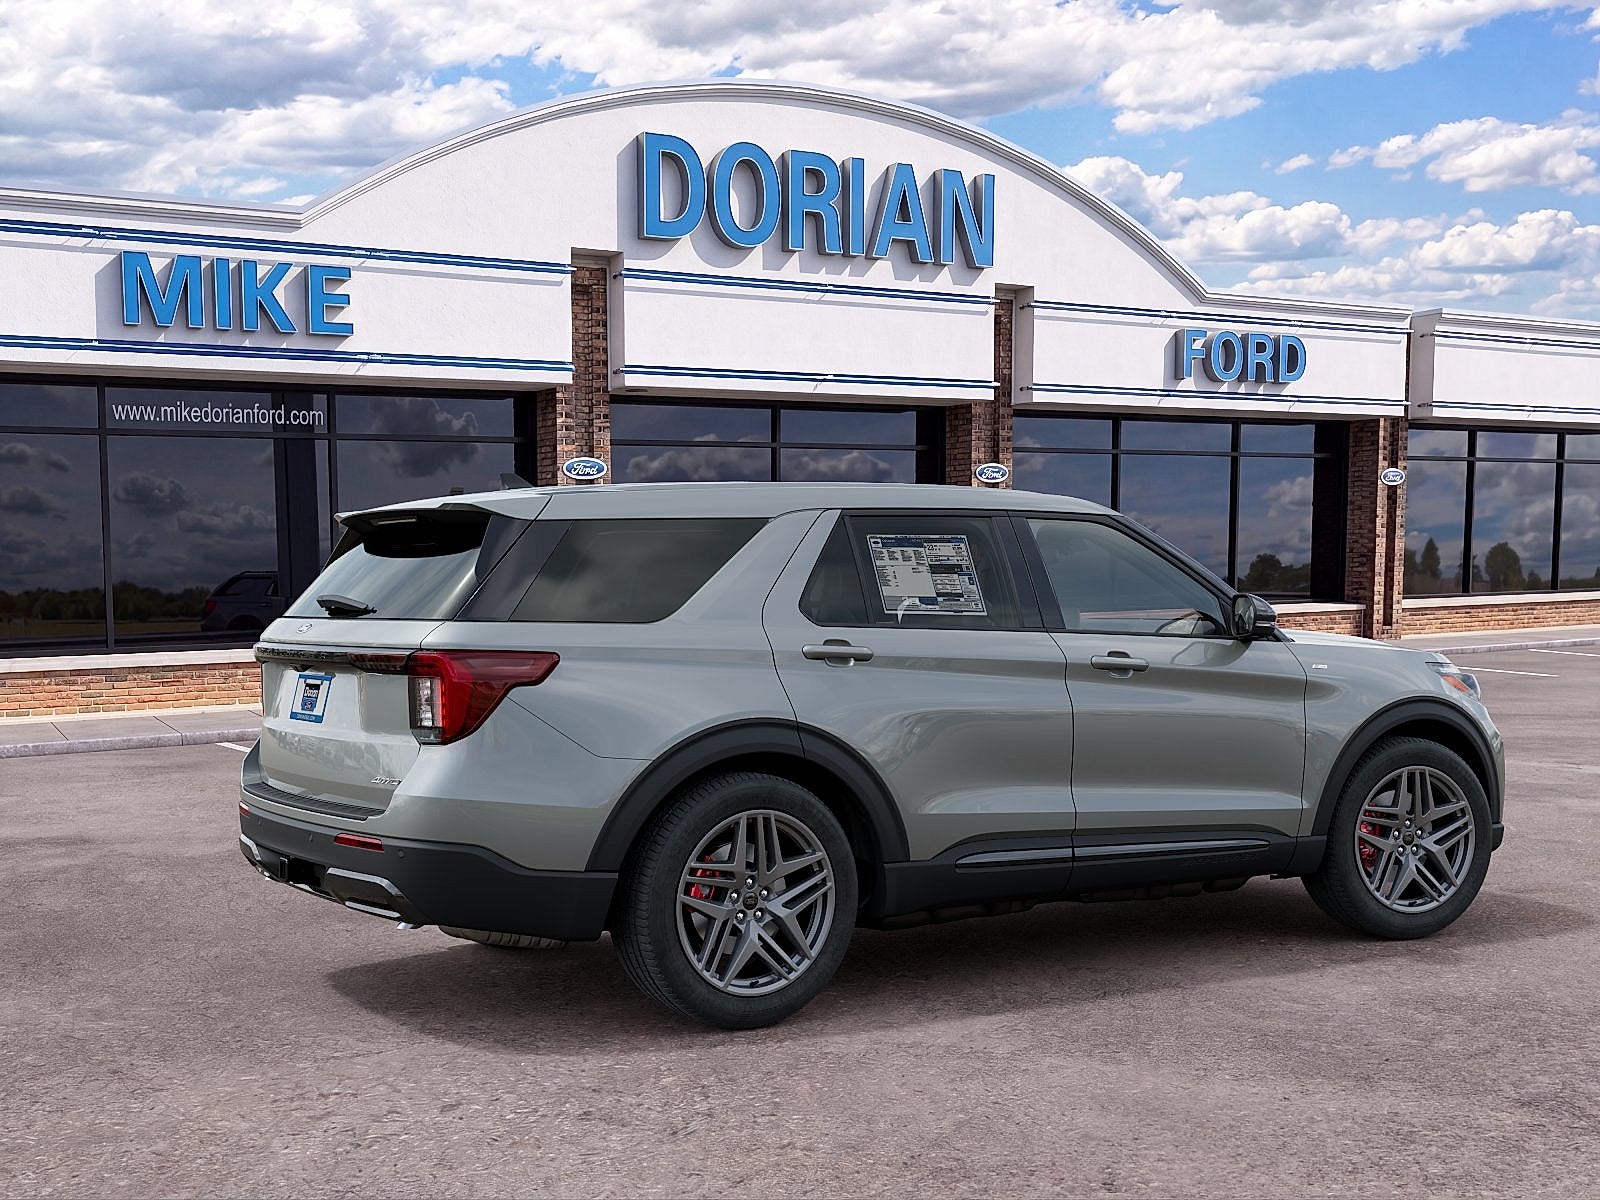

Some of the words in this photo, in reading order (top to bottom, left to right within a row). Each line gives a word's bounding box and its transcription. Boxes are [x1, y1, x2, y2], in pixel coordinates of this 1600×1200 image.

[637, 131, 995, 269] DORIAN
[121, 250, 354, 336] MIKE
[1175, 328, 1307, 384] FORD
[112, 401, 325, 426] www.mikedorianford.com
[571, 462, 599, 475] Ford
[982, 467, 1004, 479] Ford
